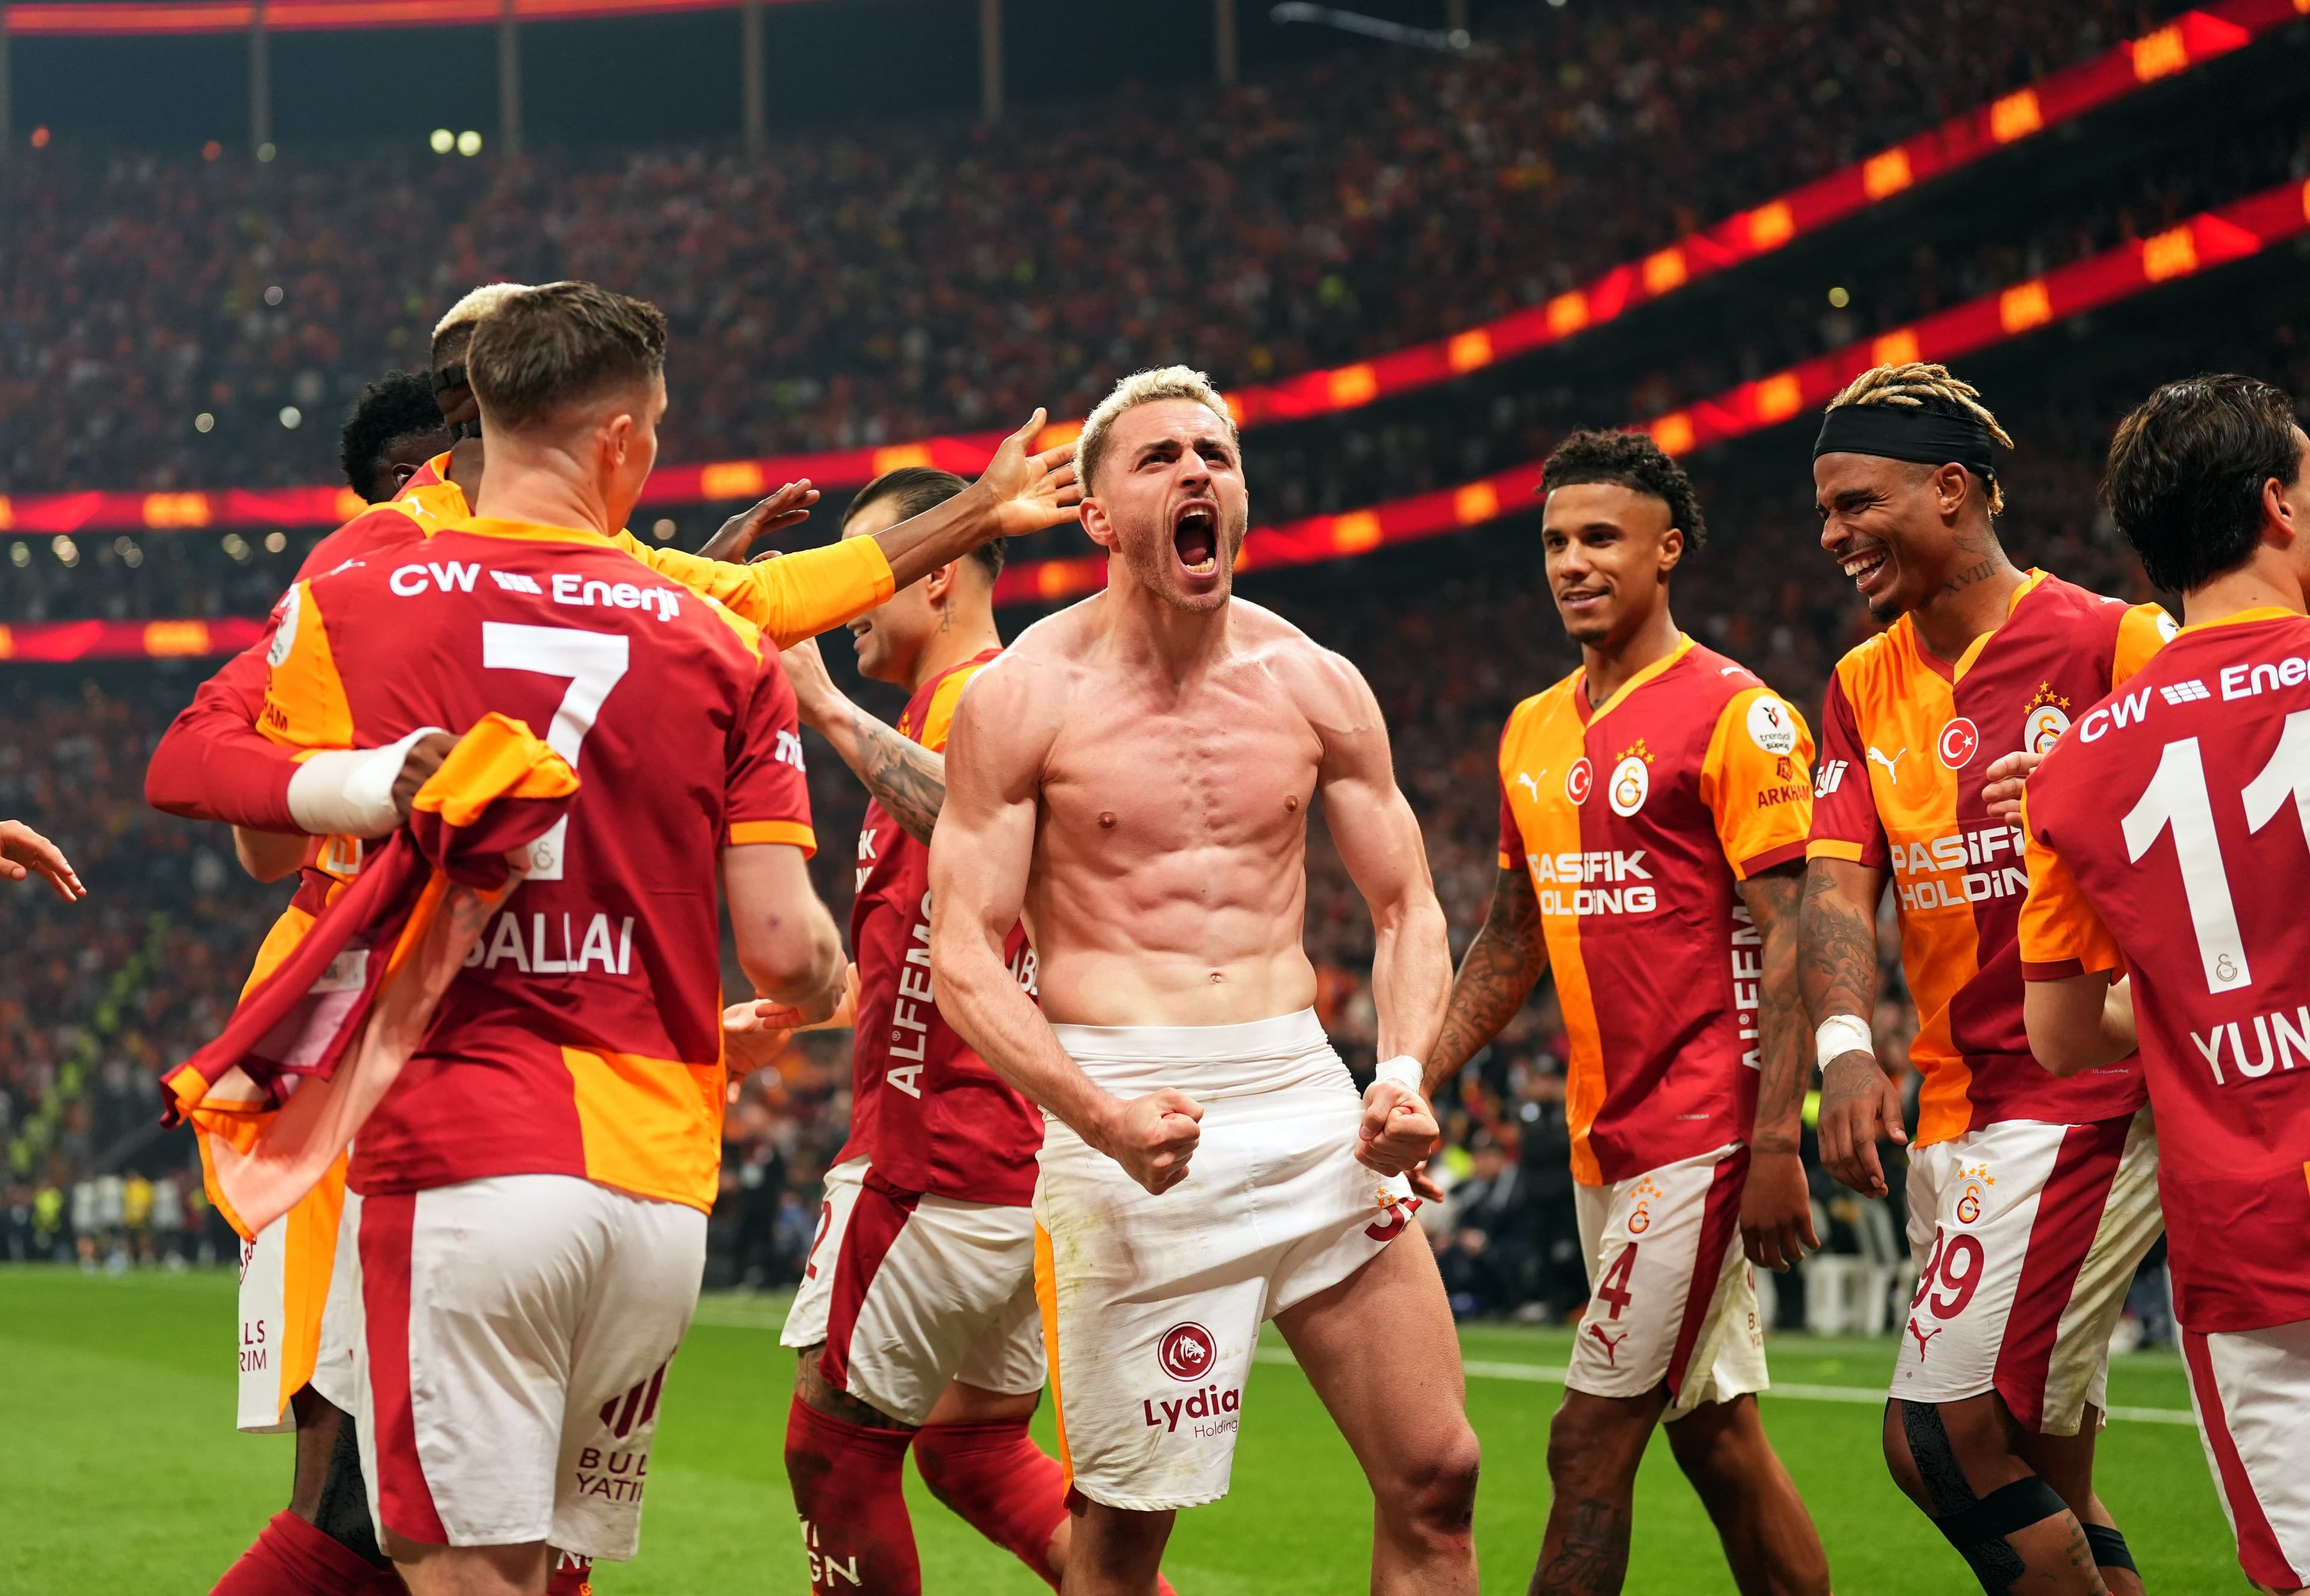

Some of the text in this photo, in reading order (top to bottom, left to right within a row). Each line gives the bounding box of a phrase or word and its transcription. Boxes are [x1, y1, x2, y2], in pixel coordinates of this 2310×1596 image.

[389, 561, 481, 597] CW
[2079, 686, 2152, 744] CW
[482, 620, 629, 881] 7
[1758, 784, 1811, 809] ARKHAM
[2189, 1005, 2310, 1086] YUN
[1597, 1241, 1639, 1321] 4
[1911, 1225, 1985, 1320] 99
[1144, 1384, 1239, 1433] Lydia
[1194, 1419, 1238, 1438] Holding
